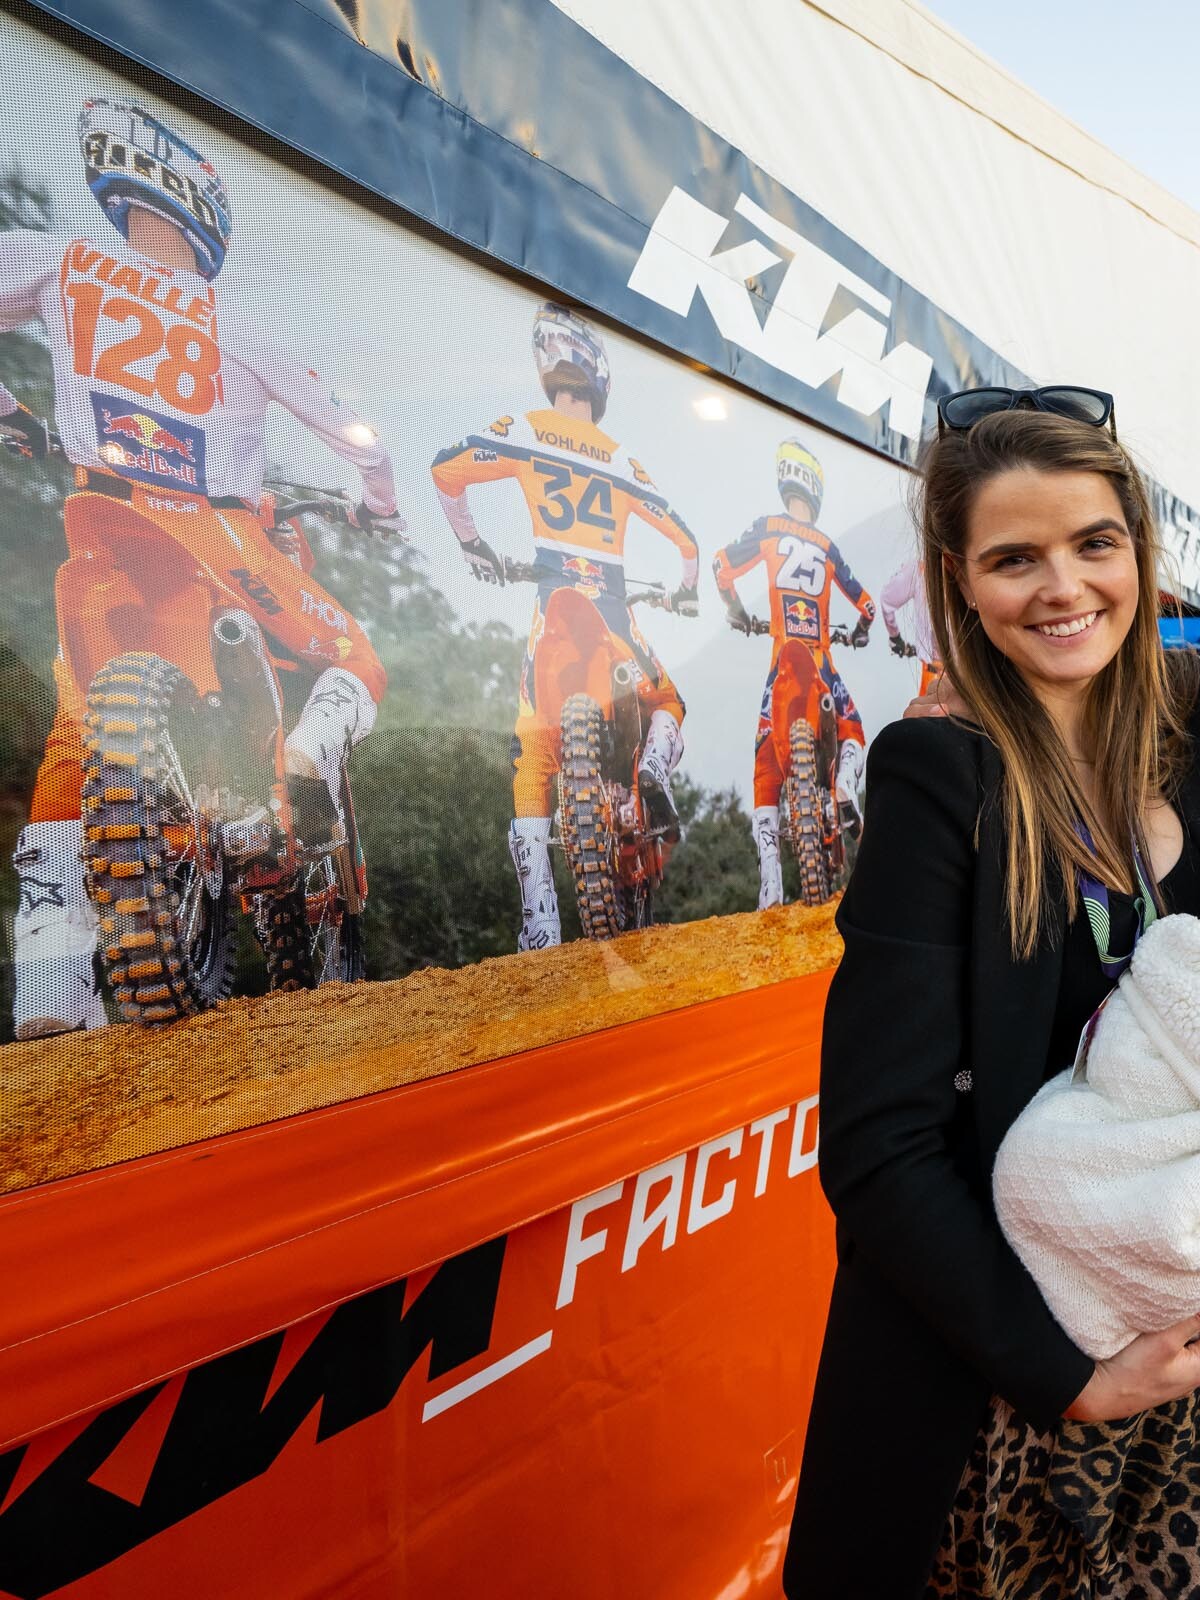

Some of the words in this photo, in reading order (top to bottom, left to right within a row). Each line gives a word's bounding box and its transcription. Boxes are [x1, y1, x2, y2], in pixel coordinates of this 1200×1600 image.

[72, 244, 216, 327] VIALLE
[627, 185, 934, 442] KTM
[68, 281, 222, 415] 128
[152, 451, 198, 487] Bull
[535, 428, 612, 464] VOHLAND
[533, 458, 617, 532] 34
[776, 535, 828, 598] 25
[555, 1093, 821, 1311] FACTO
